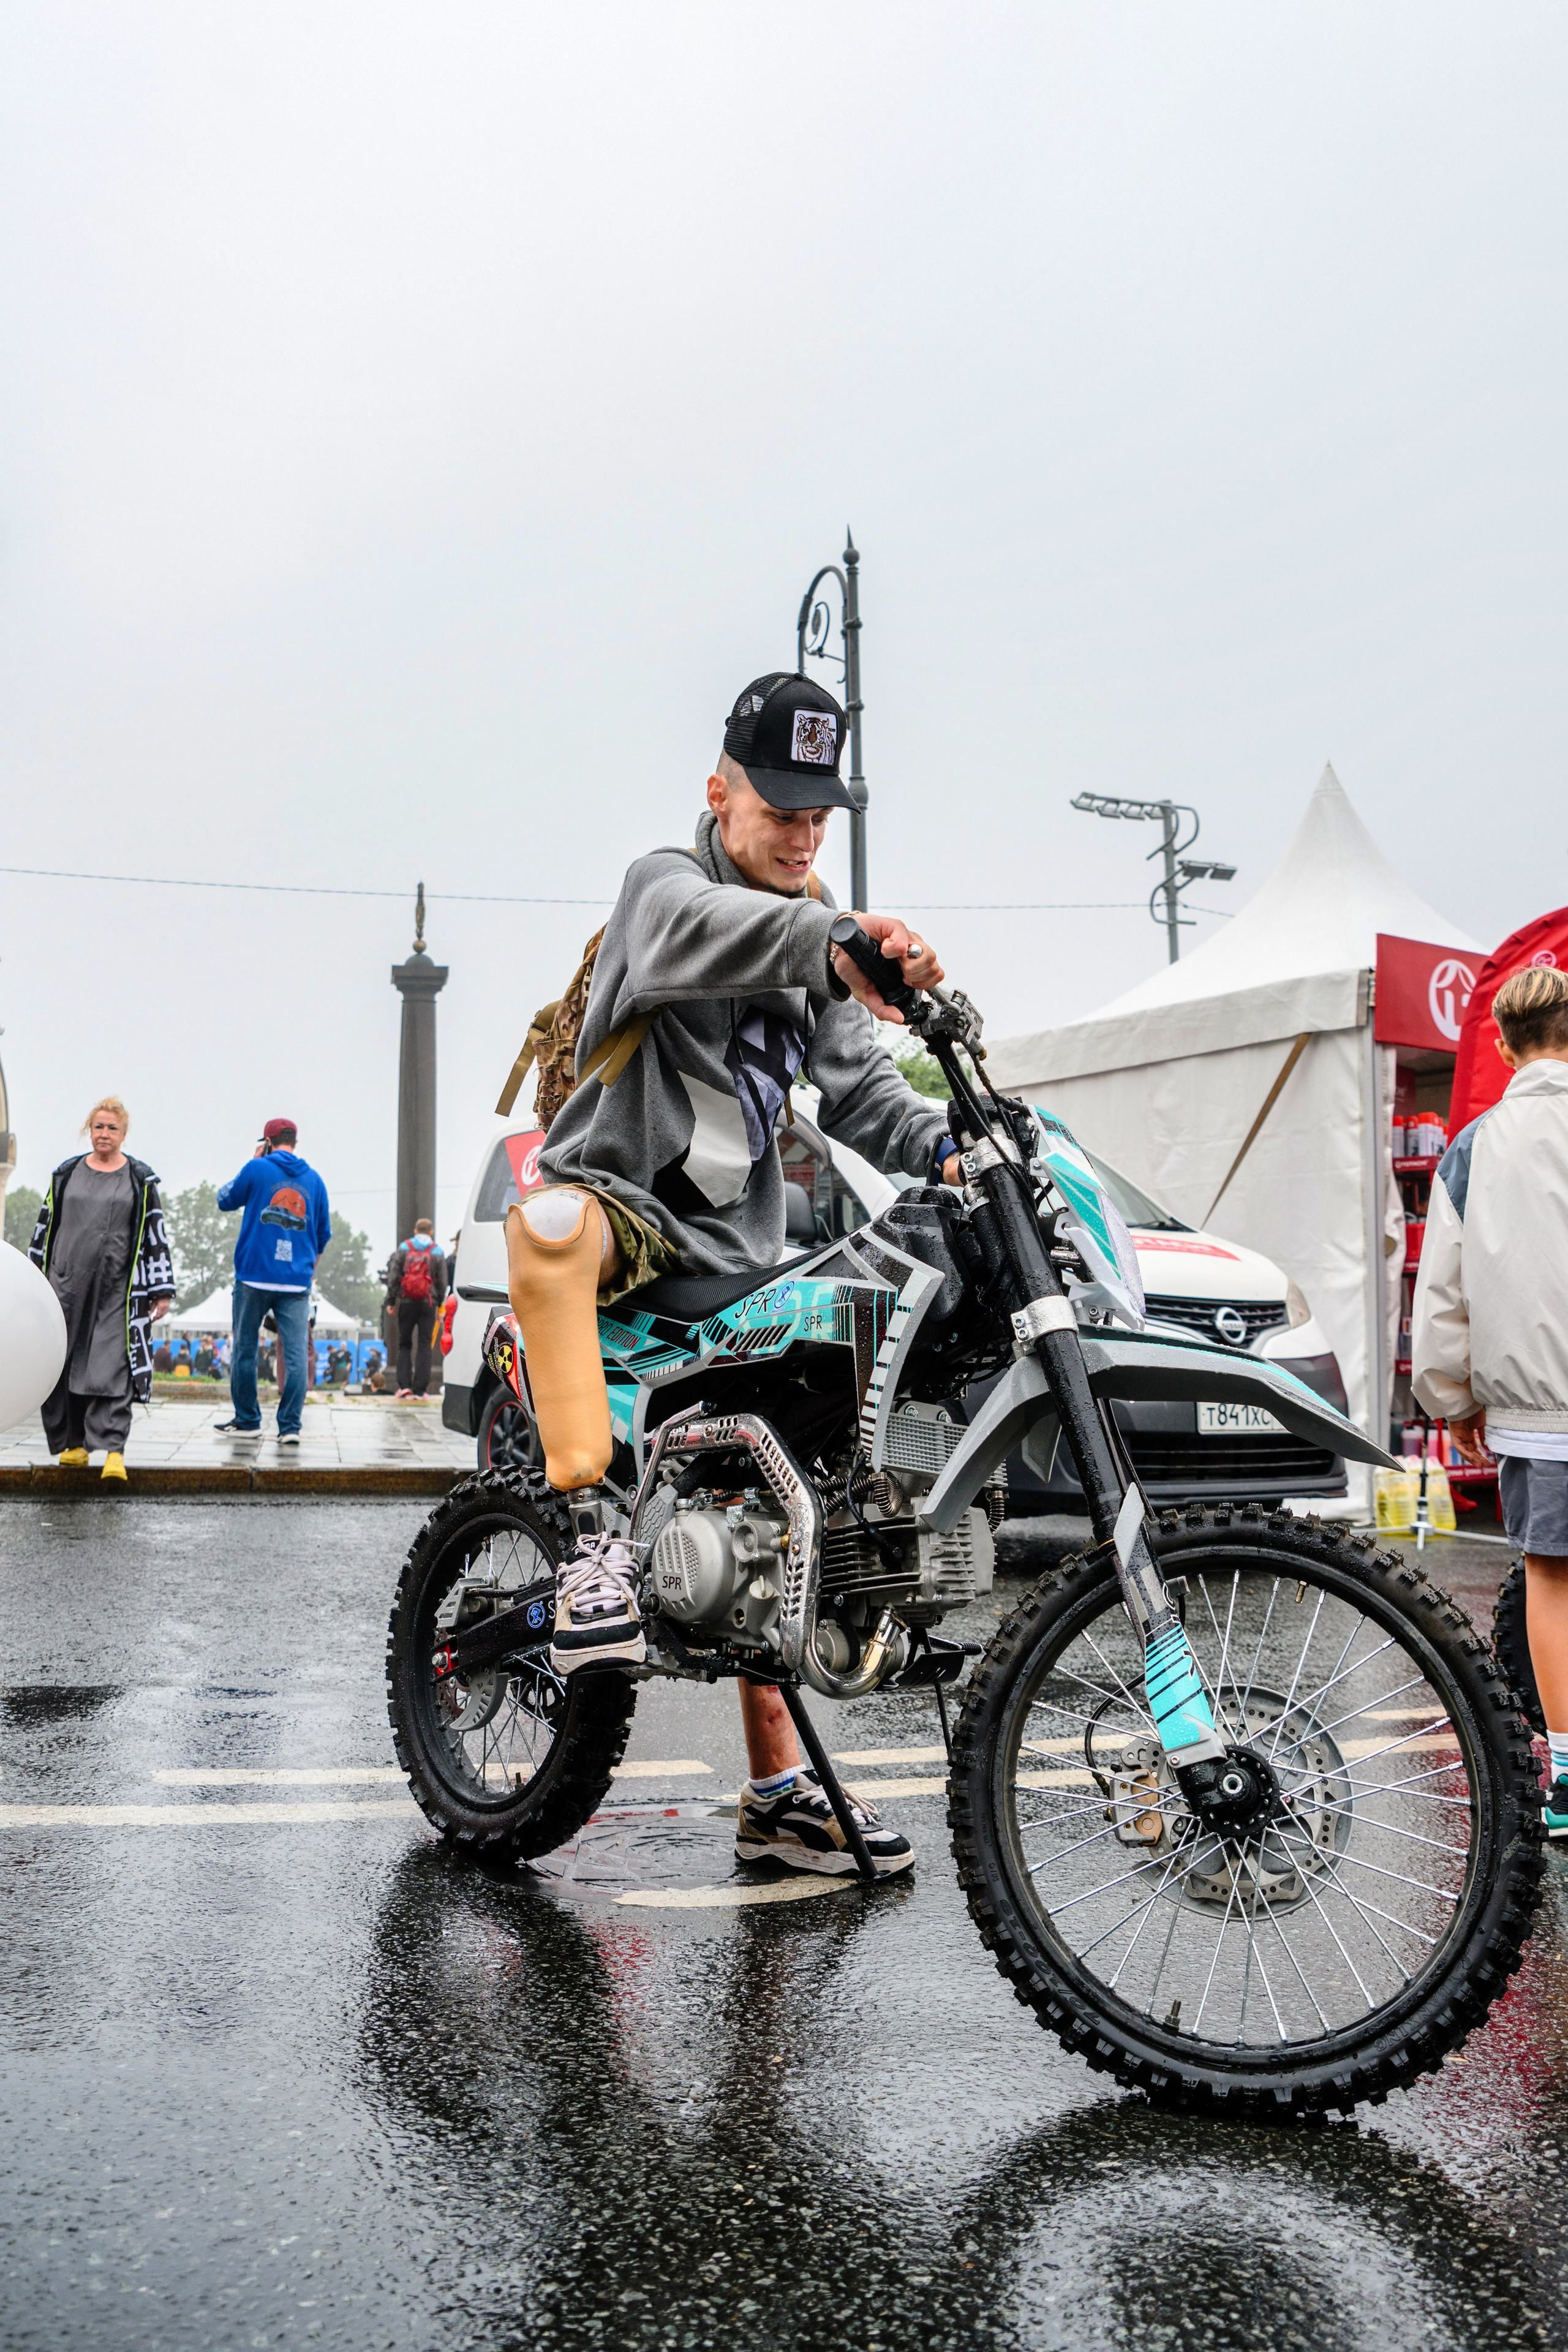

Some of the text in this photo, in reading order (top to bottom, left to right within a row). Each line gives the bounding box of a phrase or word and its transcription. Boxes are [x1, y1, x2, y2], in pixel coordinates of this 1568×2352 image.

[735, 1289, 777, 1319] SPR
[804, 1315, 823, 1332] SPR
[606, 1326, 641, 1351] EDITION
[662, 1575, 682, 1591] SPR
[1373, 1976, 1462, 2052] YUANXING
